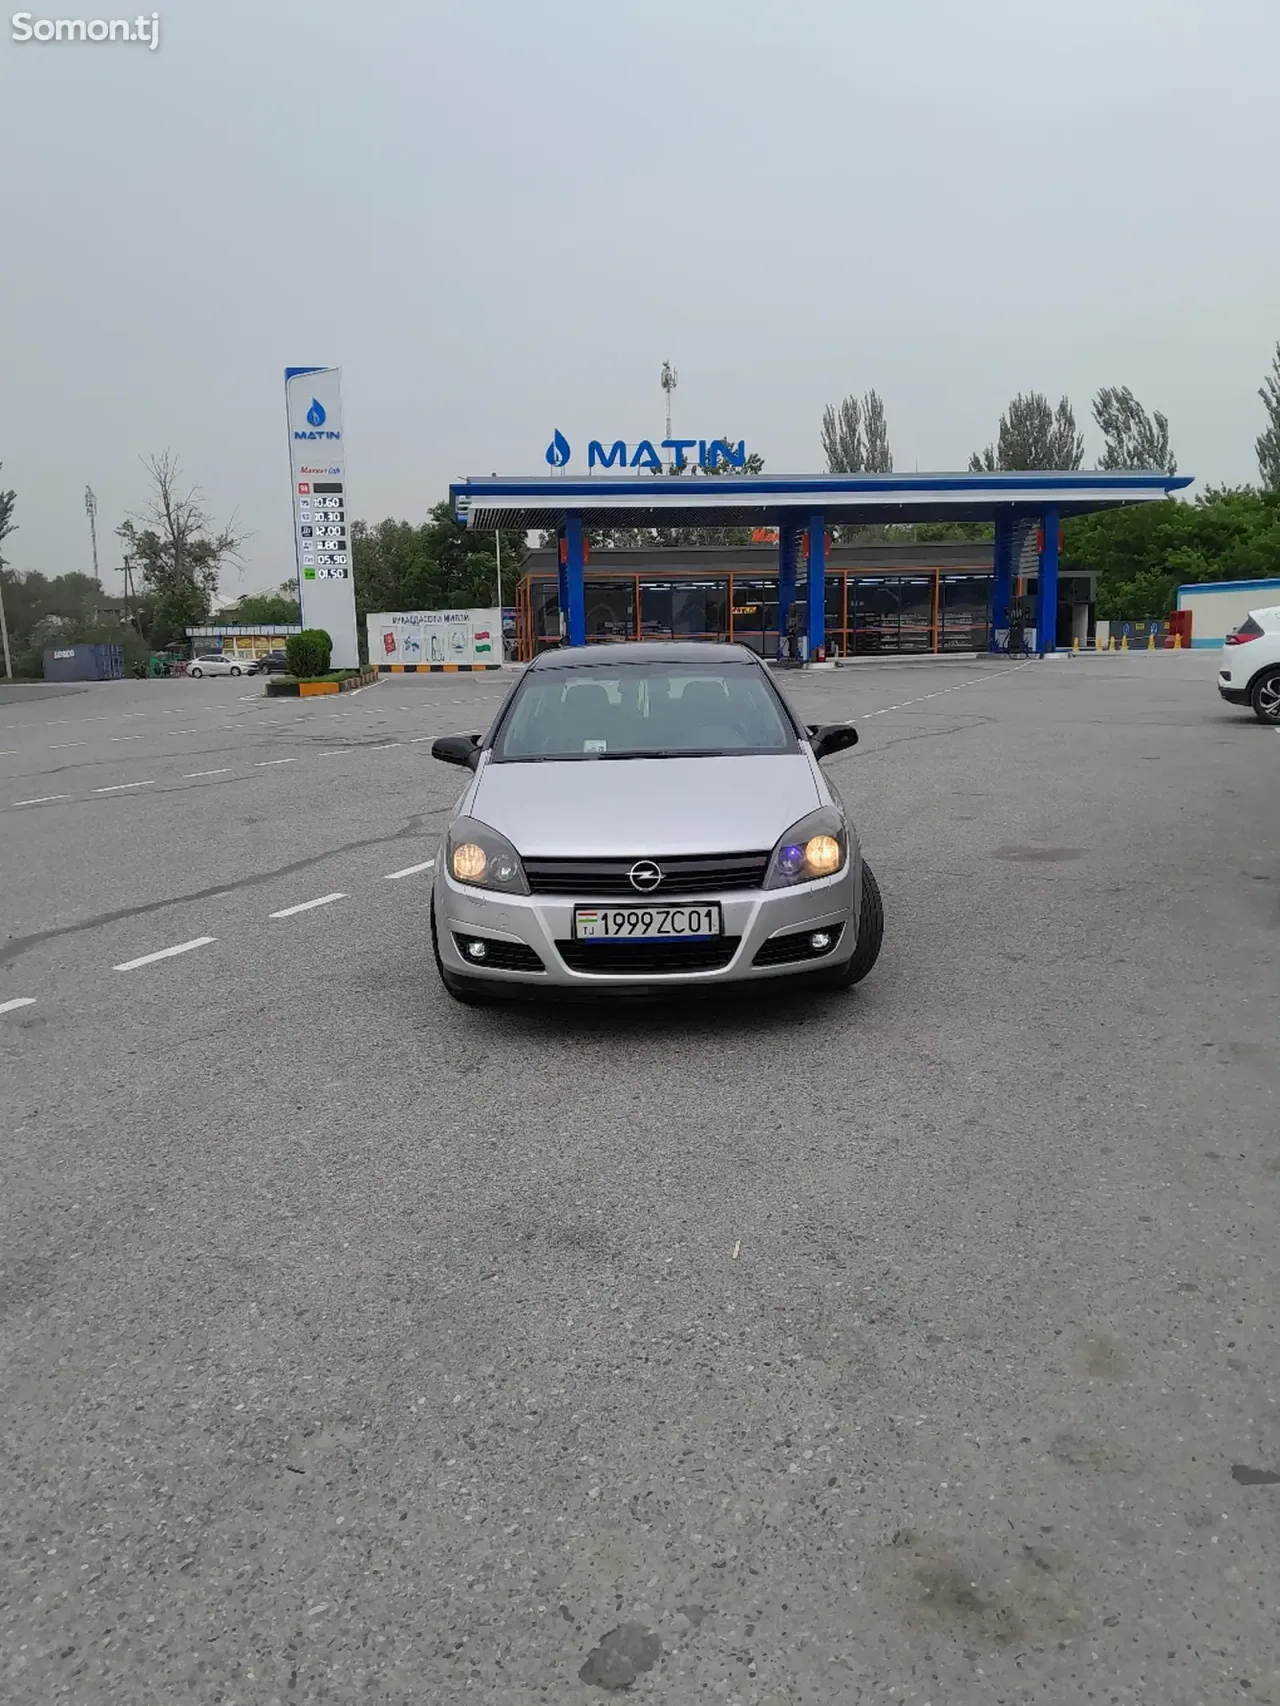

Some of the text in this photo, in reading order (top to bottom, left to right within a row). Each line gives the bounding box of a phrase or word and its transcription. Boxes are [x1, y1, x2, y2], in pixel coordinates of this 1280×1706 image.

[294, 431, 340, 440] MATIN
[588, 439, 745, 468] MATIN
[318, 555, 347, 564] 05.90
[319, 569, 344, 579] 01.50
[601, 909, 713, 936] 1999ZC01
[582, 926, 595, 936] TJ
